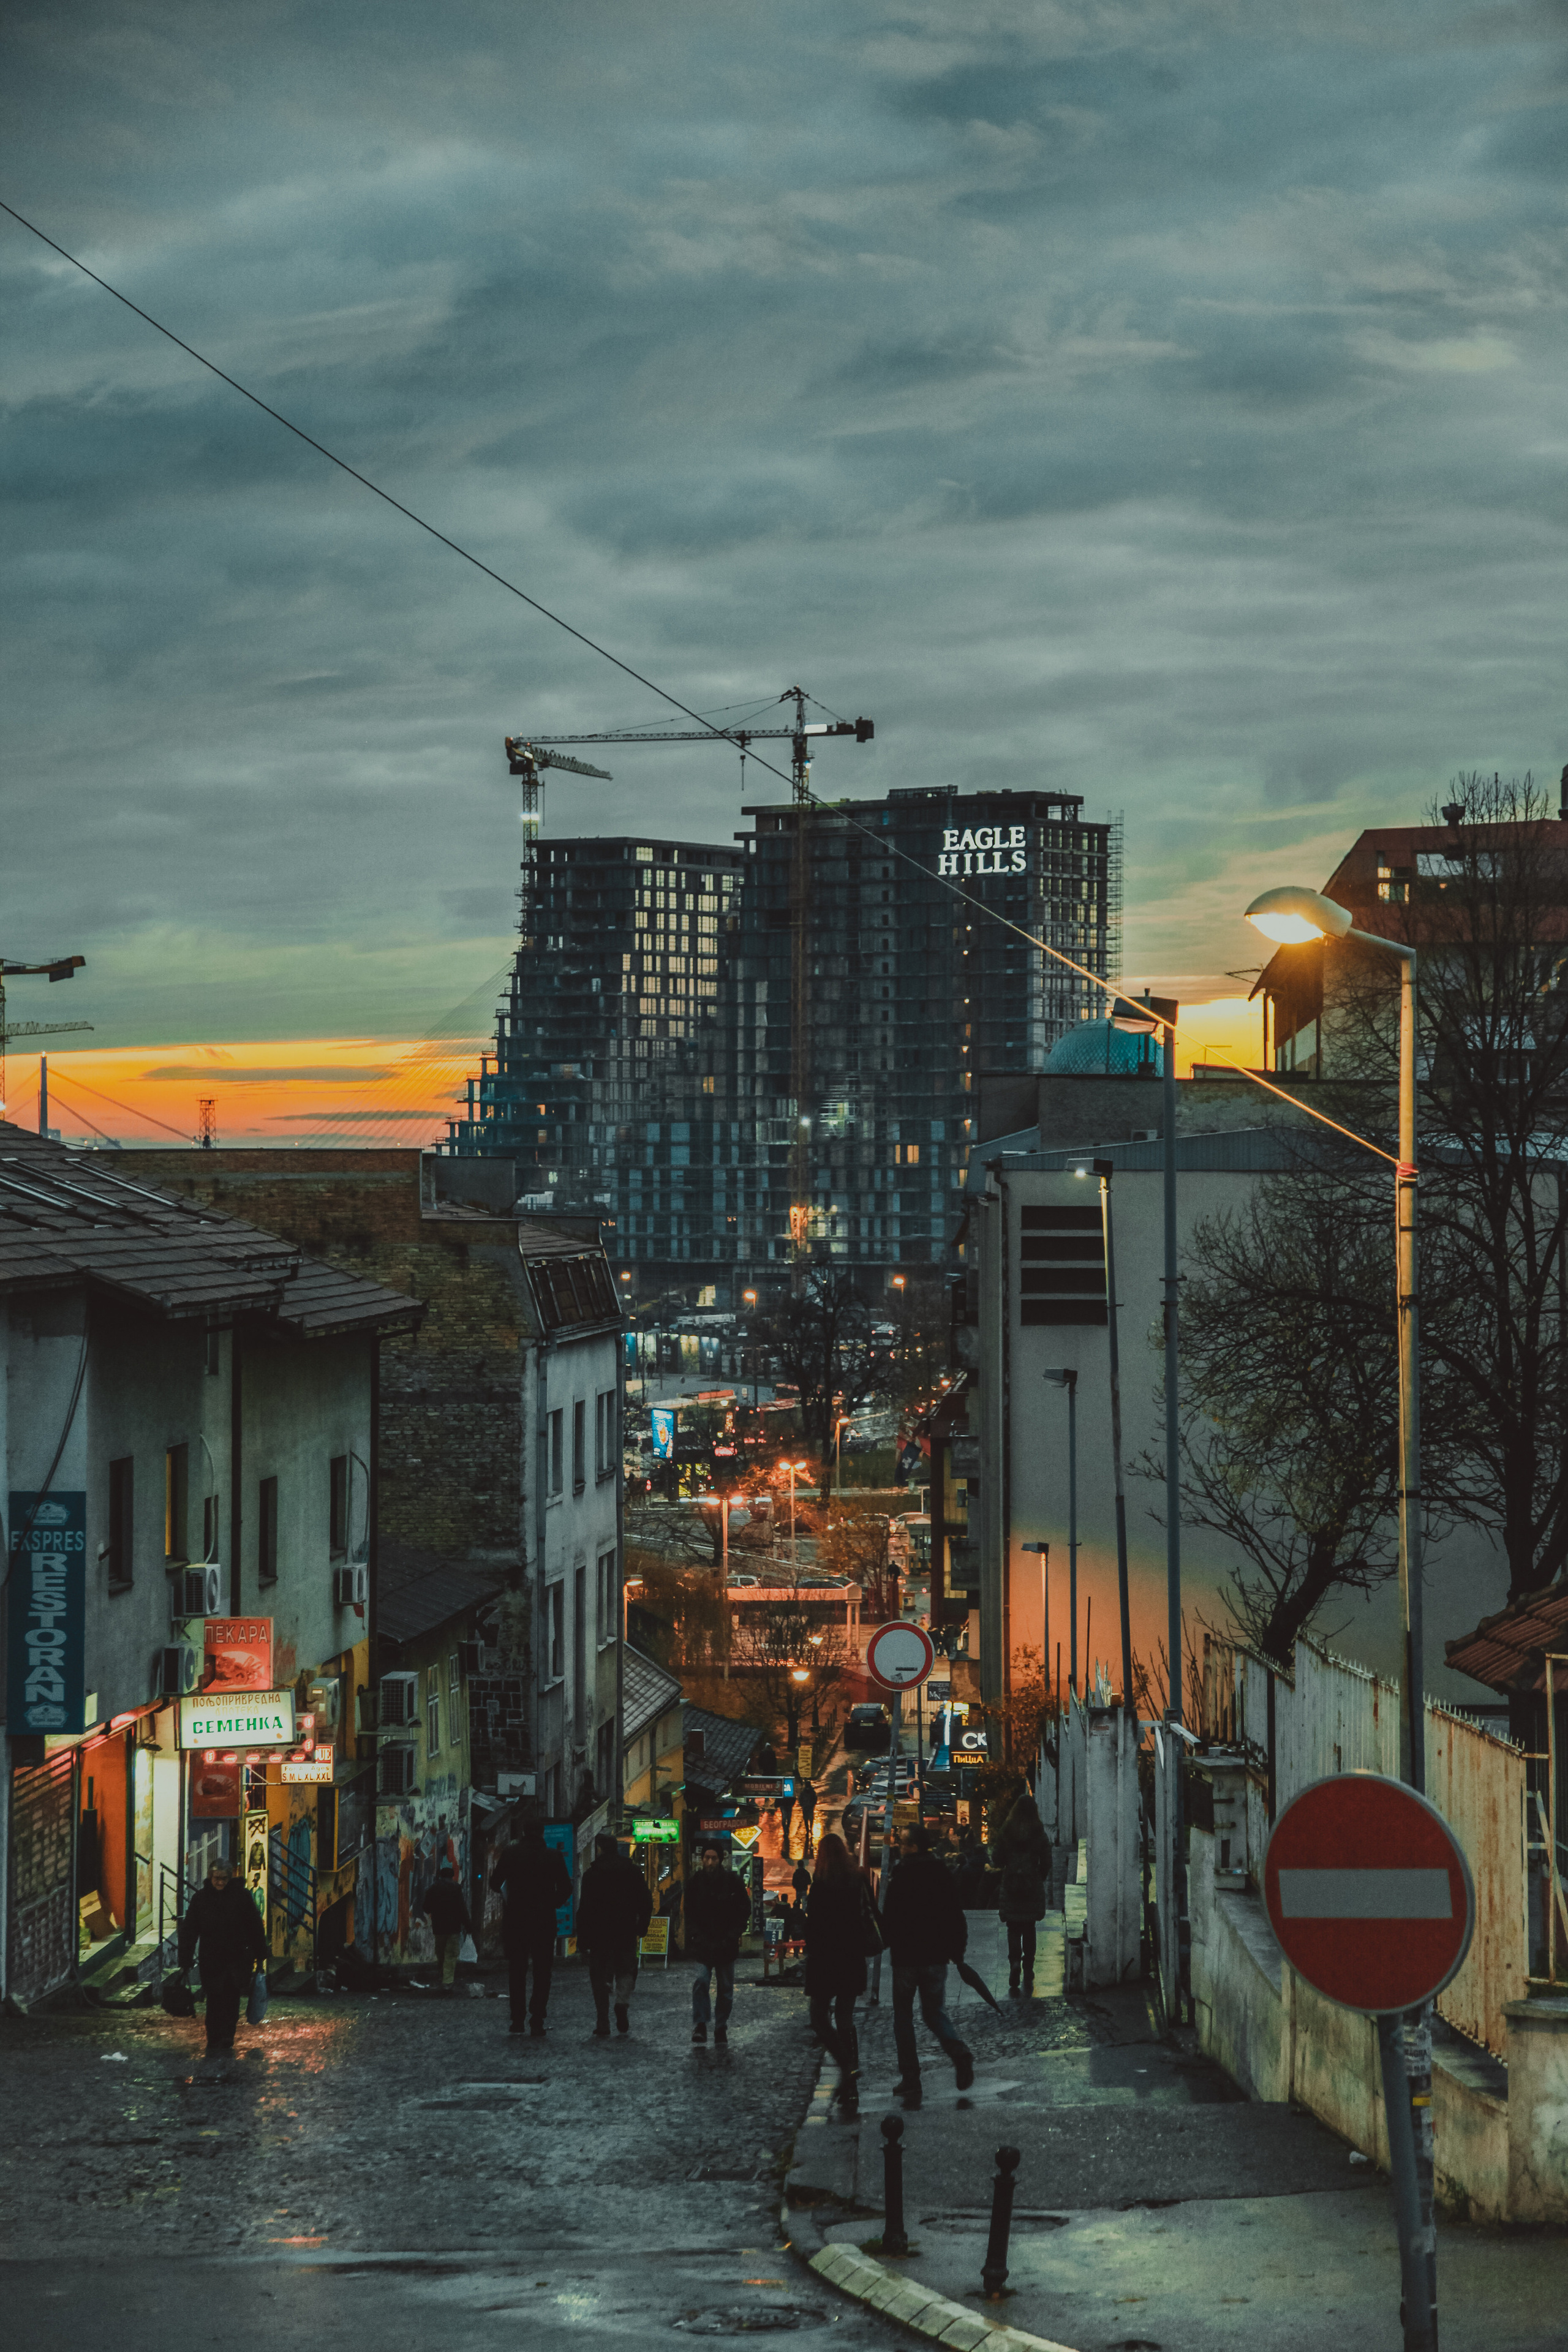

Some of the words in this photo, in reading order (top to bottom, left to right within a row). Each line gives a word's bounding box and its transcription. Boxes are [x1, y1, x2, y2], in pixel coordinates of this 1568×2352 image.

[943, 826, 1026, 851] EAGLE
[938, 850, 1027, 876] HILLS
[10, 1531, 85, 1551] EKSPRES
[24, 1552, 67, 1702] RESTORAN
[204, 1626, 268, 1643] ПЕКАРА
[193, 1694, 281, 1708] ПОЉОПРИВРЕДНА
[193, 1716, 283, 1734] СЕМЕНКА
[704, 1819, 747, 1829] БЕОГРАДСКИ
